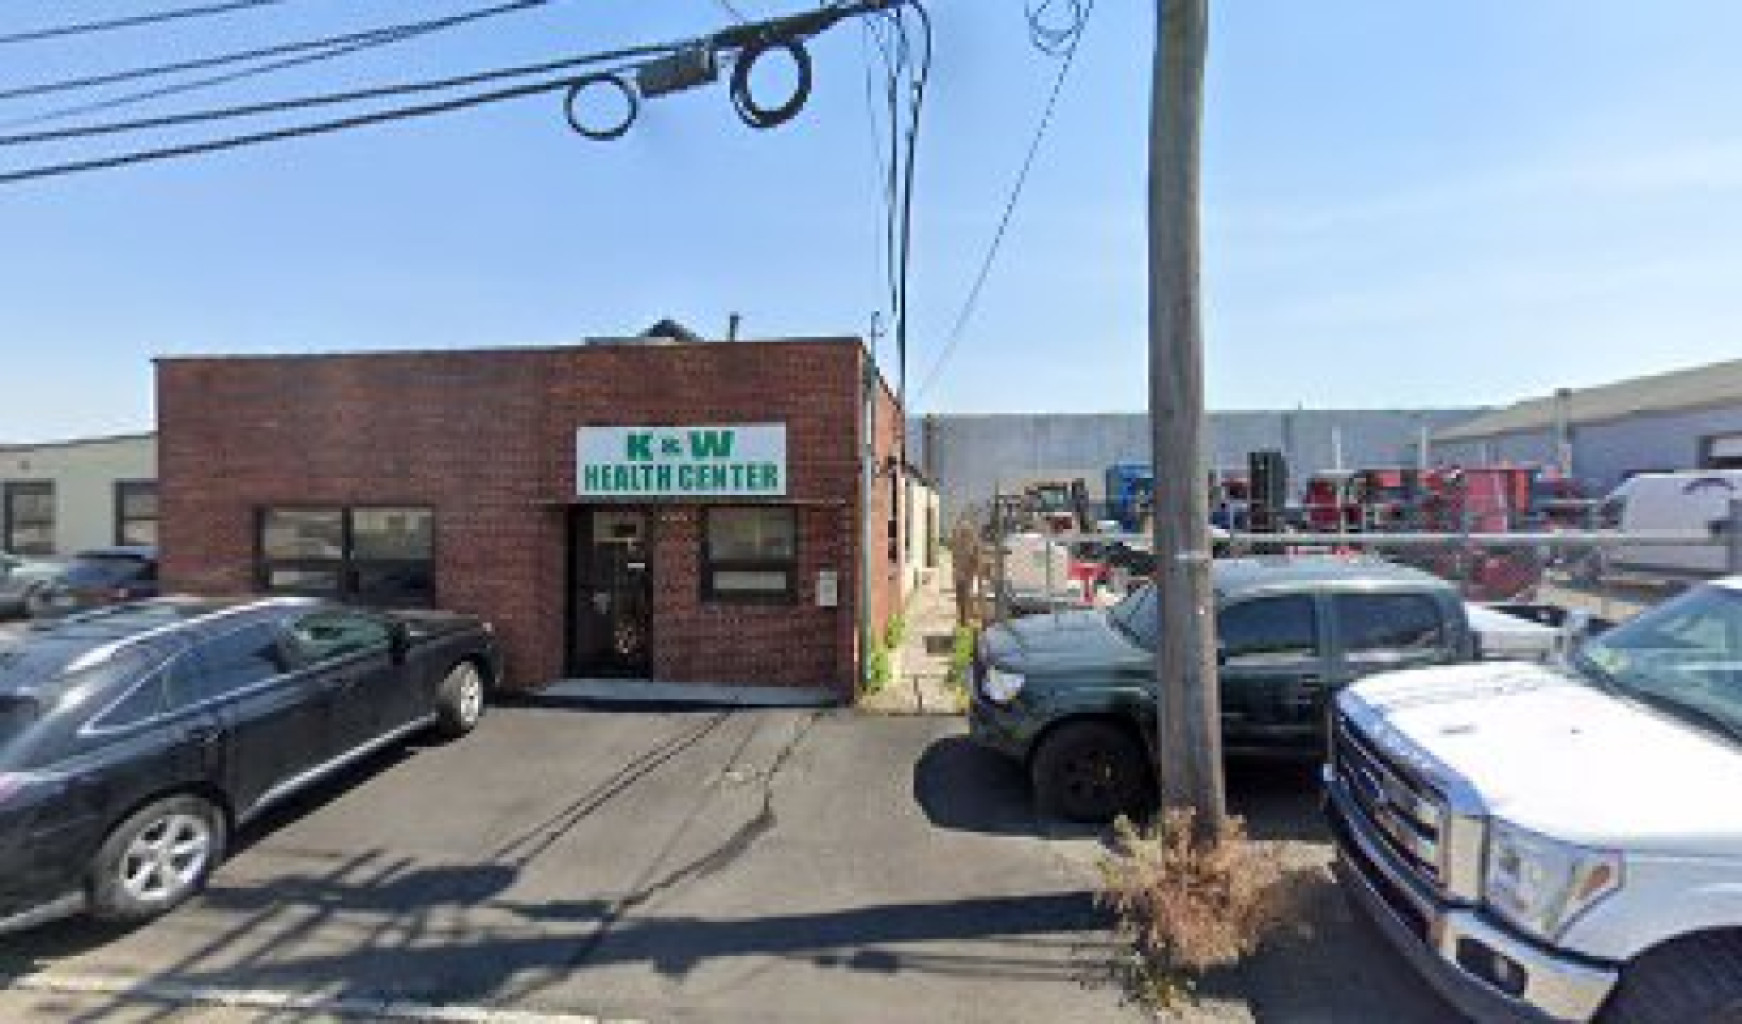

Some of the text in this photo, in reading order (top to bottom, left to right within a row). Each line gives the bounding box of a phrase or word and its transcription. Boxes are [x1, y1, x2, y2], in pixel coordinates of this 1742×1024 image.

[627, 431, 735, 460] K & W
[584, 462, 778, 491] HEALTH CENTER
